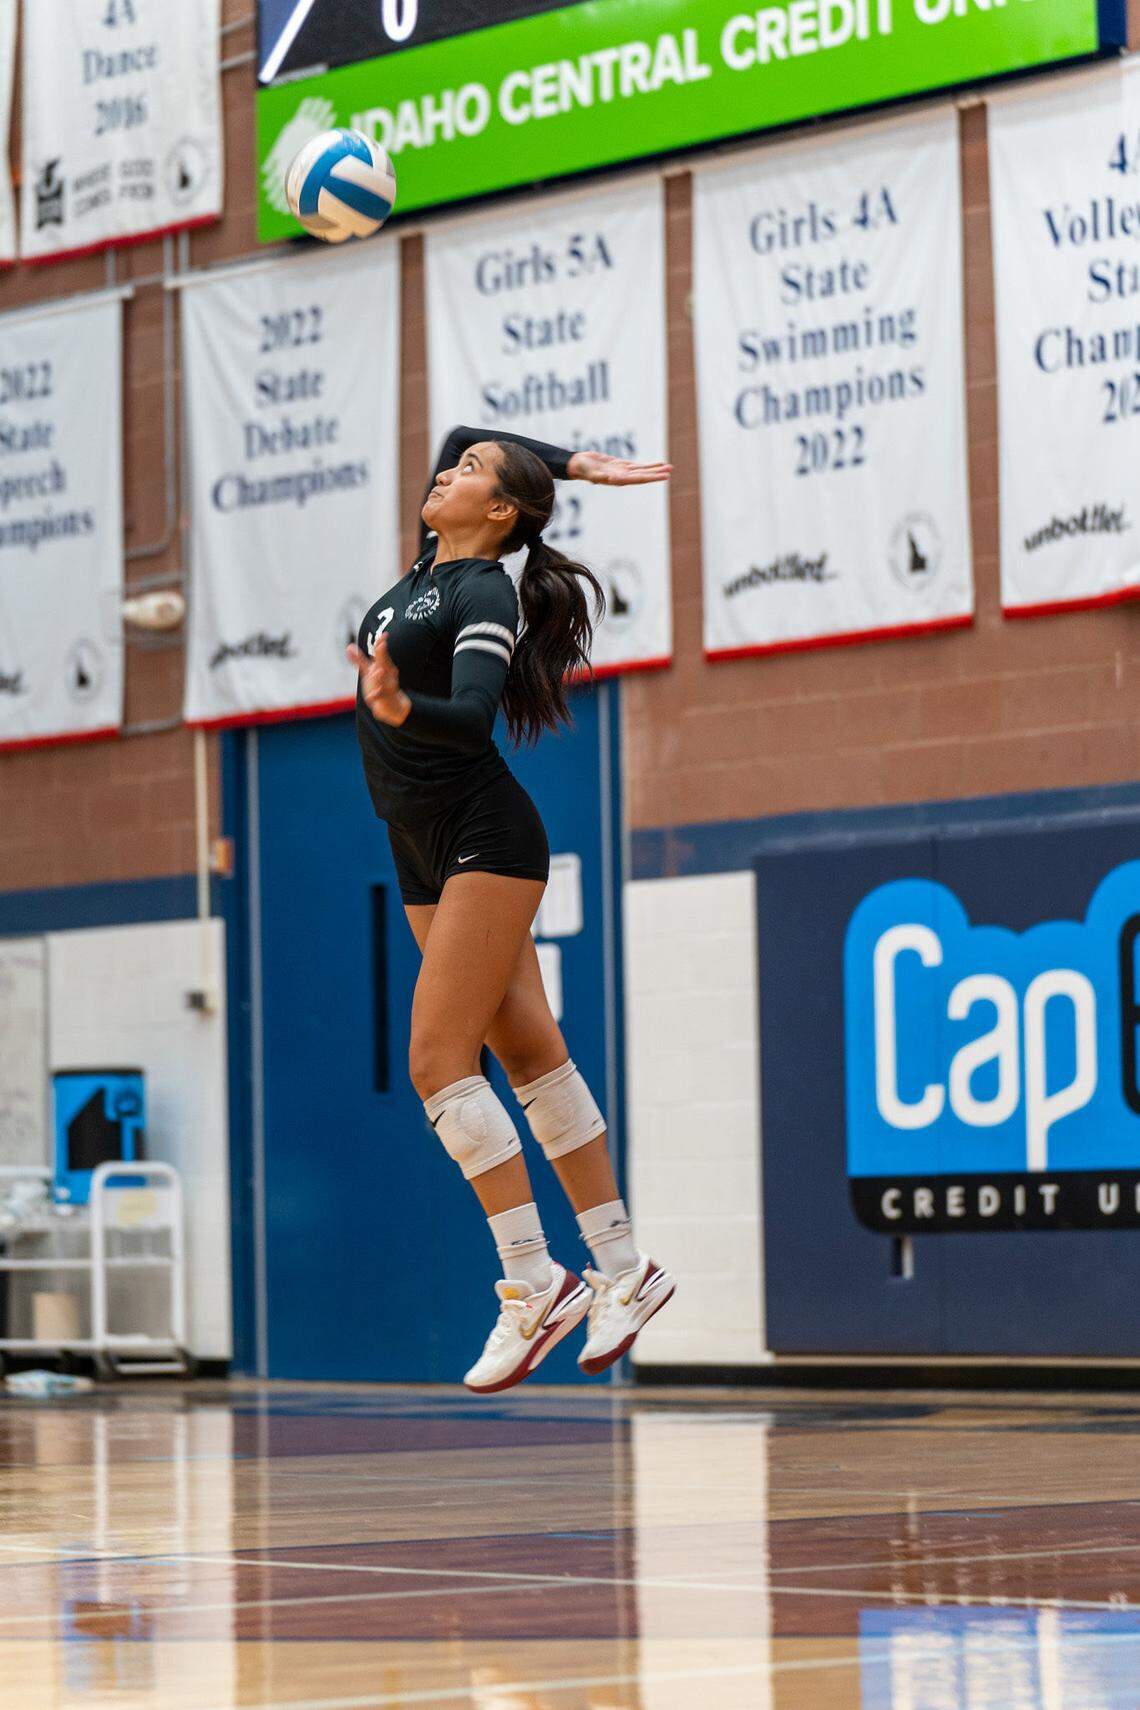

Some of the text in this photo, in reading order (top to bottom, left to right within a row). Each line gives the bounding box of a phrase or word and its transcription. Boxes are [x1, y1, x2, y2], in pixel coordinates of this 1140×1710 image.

[498, 28, 713, 125] CENTRAL
[1108, 131, 1140, 175] 4
[750, 184, 898, 256] Girls 4A
[1042, 196, 1140, 249] Volle
[475, 229, 614, 297] Girls 5A
[780, 258, 870, 306] State
[260, 305, 323, 353] 2022
[502, 308, 586, 354] State
[737, 306, 918, 372] Swimming
[255, 368, 325, 408] State
[481, 360, 611, 424] Softball
[734, 365, 926, 430] Champions
[243, 415, 339, 461] Debate
[795, 426, 866, 476] 2022
[211, 456, 370, 514] Champions
[880, 1183, 1140, 1219] CREDIT U
